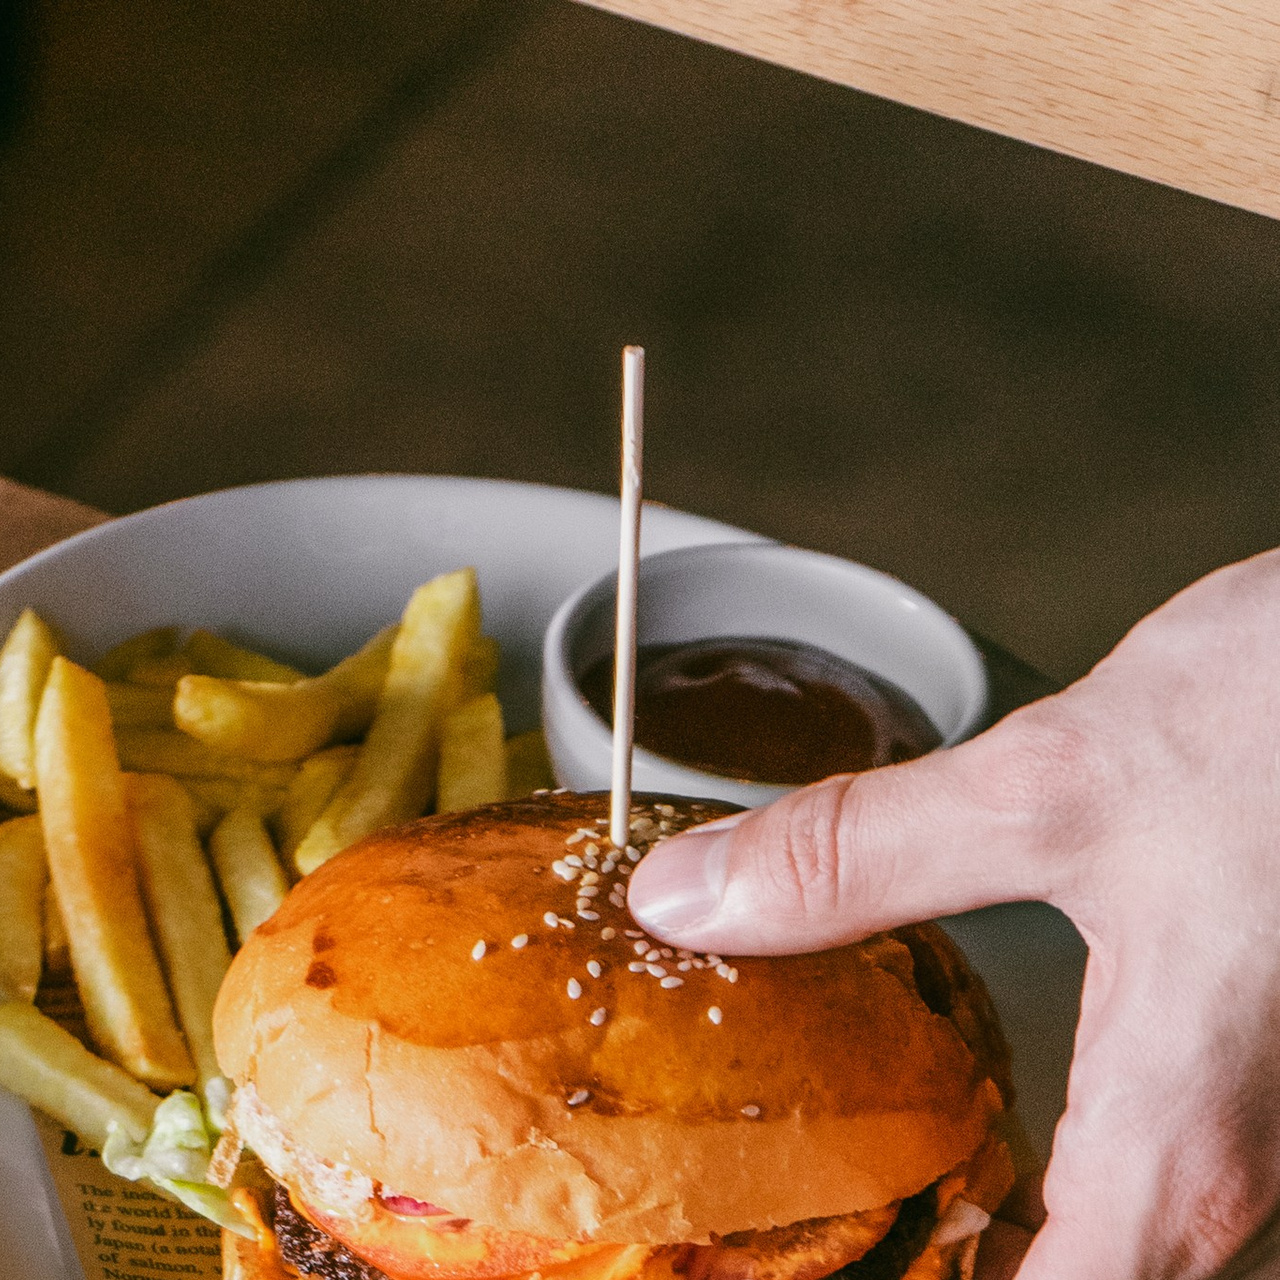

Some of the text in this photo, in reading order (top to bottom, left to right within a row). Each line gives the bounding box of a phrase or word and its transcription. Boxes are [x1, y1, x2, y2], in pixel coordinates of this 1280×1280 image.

[77, 1184, 114, 1197] The
[116, 1205, 170, 1219] world
[111, 1218, 166, 1236] found
[171, 1226, 190, 1238] in
[93, 1233, 146, 1250] Japan
[98, 1252, 120, 1265] of
[129, 1257, 204, 1276] salmon,
